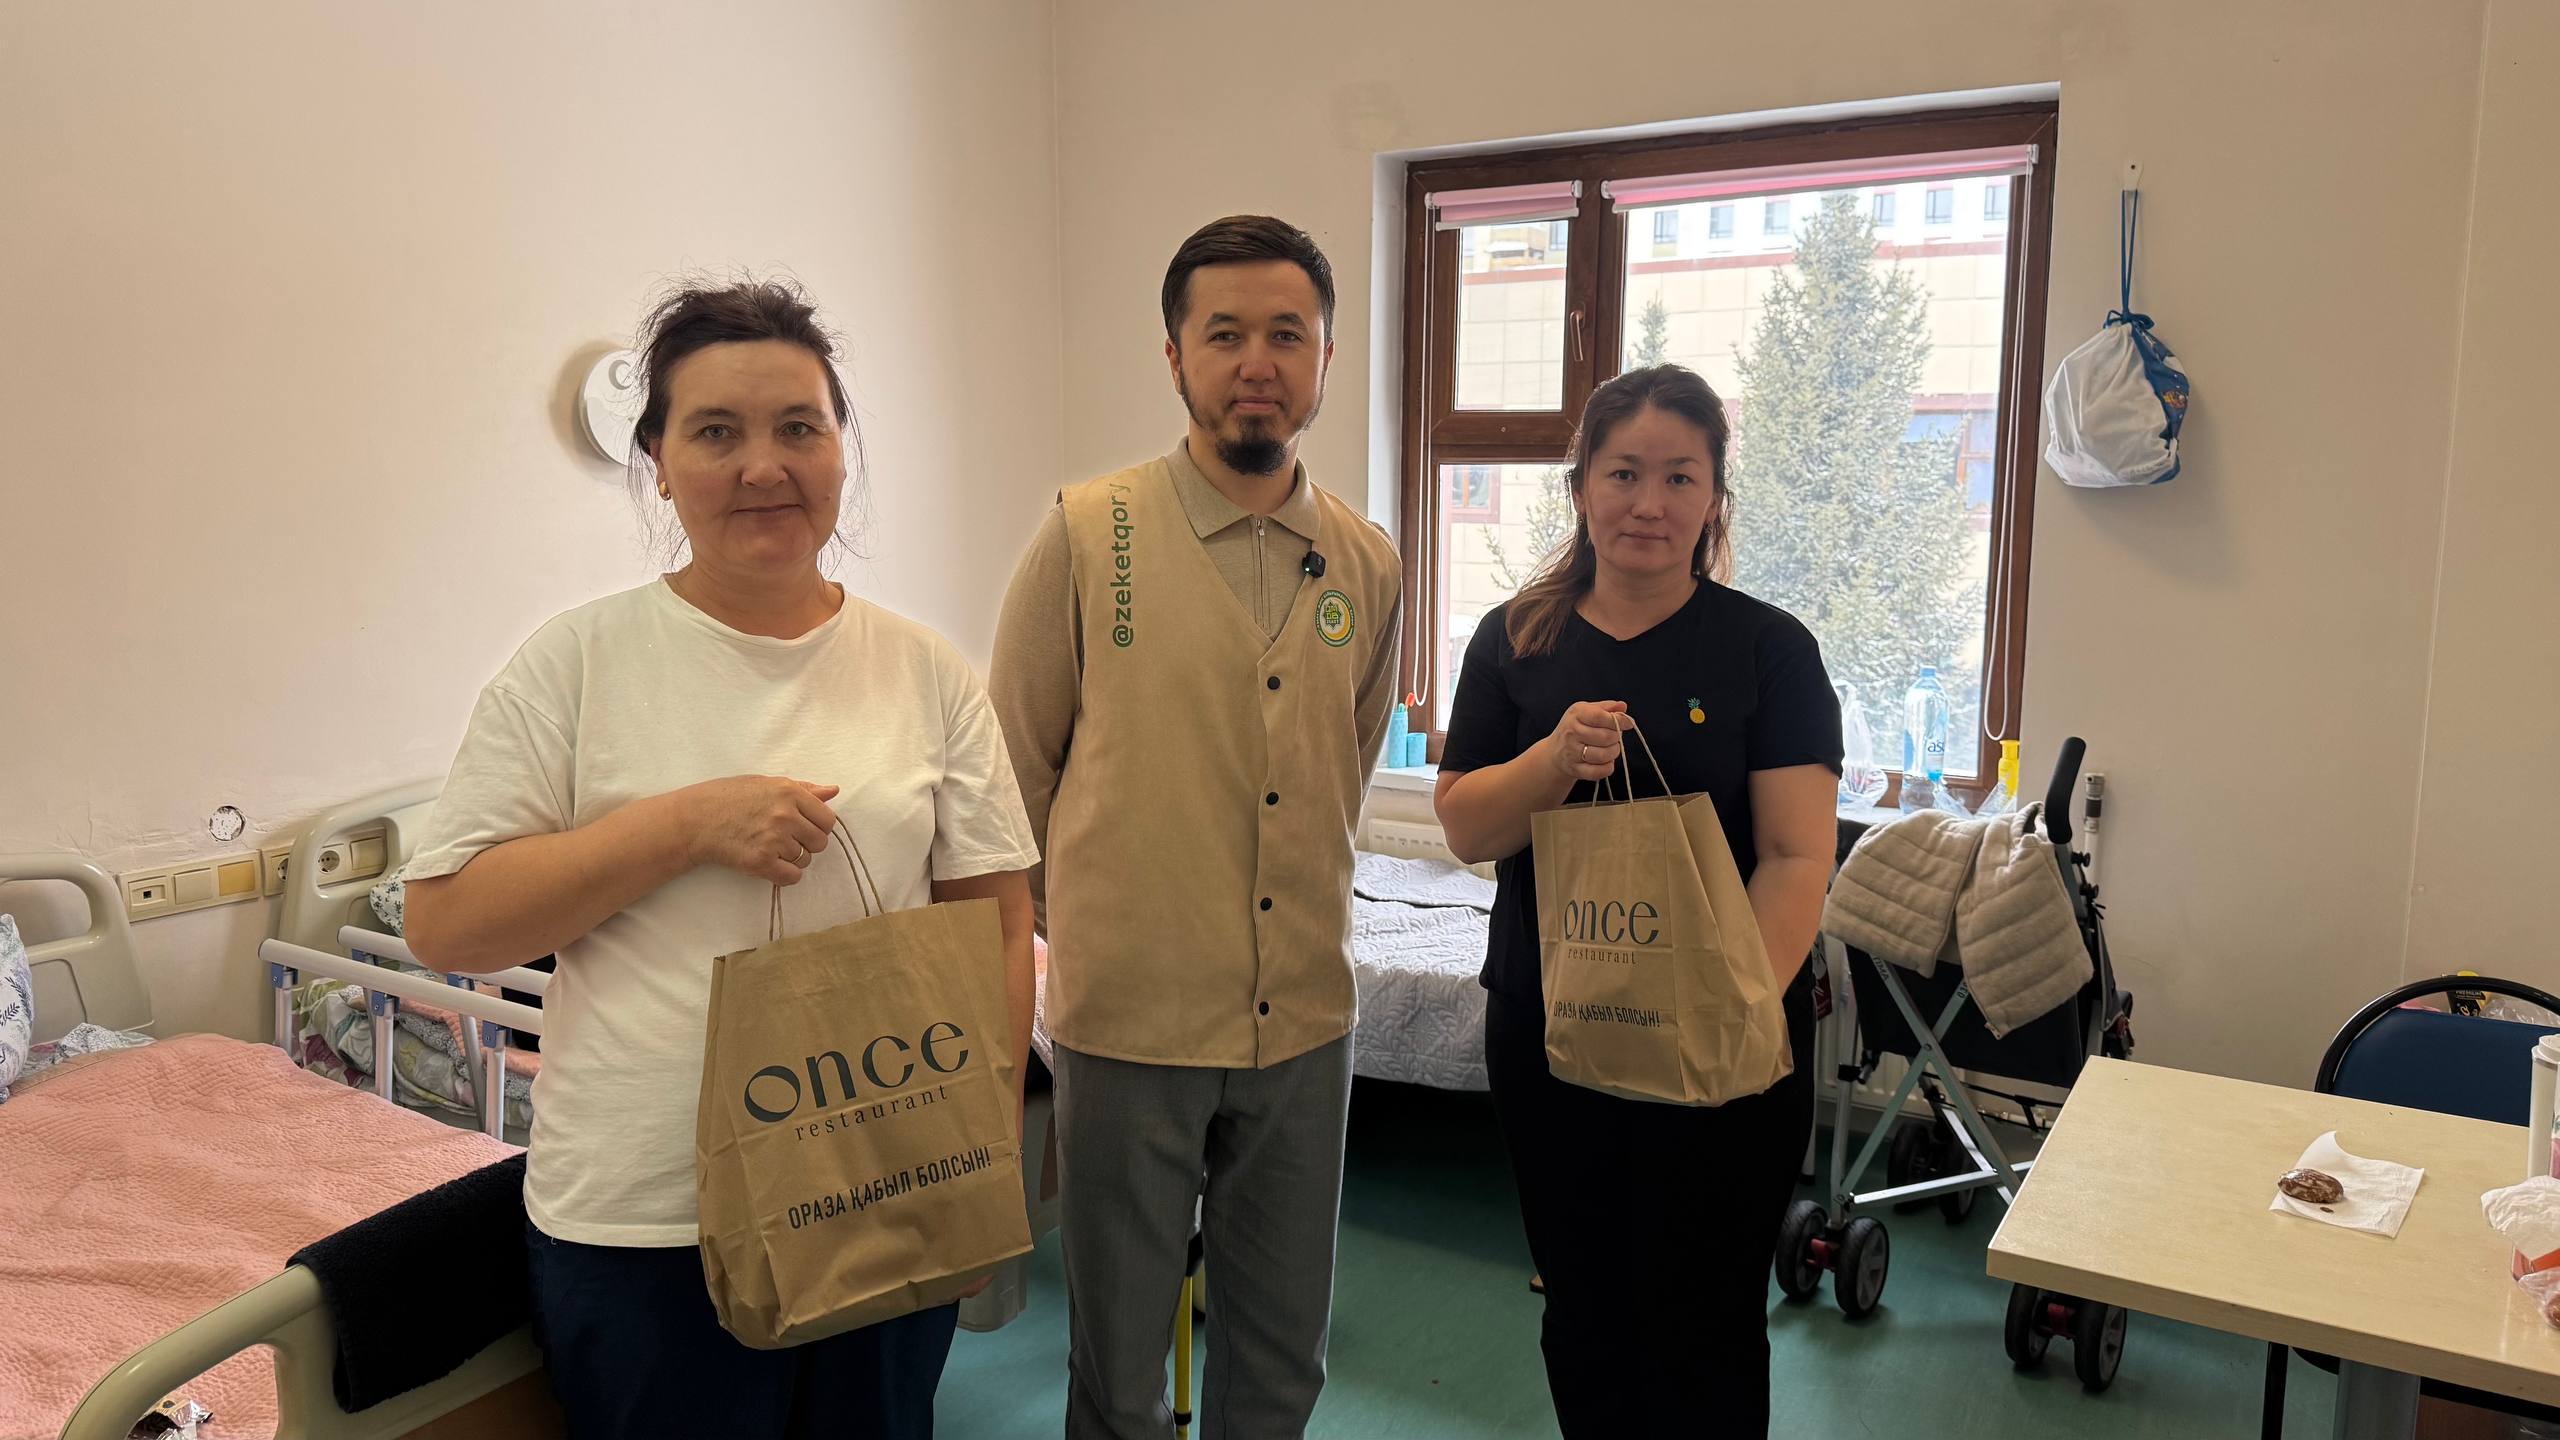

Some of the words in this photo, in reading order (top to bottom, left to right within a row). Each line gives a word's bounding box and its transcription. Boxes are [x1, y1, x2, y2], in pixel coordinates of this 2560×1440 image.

[1109, 483, 1135, 648] @zeketqory
[1564, 899, 1660, 945] once
[1567, 947, 1637, 965] restaurant
[1553, 1000, 1577, 1019] ОРАЗА
[1578, 1003, 1614, 1024] ҚАБЫЛ
[1614, 1006, 1661, 1028] БОЛСЫН!
[743, 1021, 970, 1123] once
[794, 1083, 949, 1142] restaurant
[788, 1192, 847, 1230] ОРАЗА
[849, 1170, 912, 1212] ҚАБЫЛ
[915, 1146, 992, 1188] БОЛСЫН!
